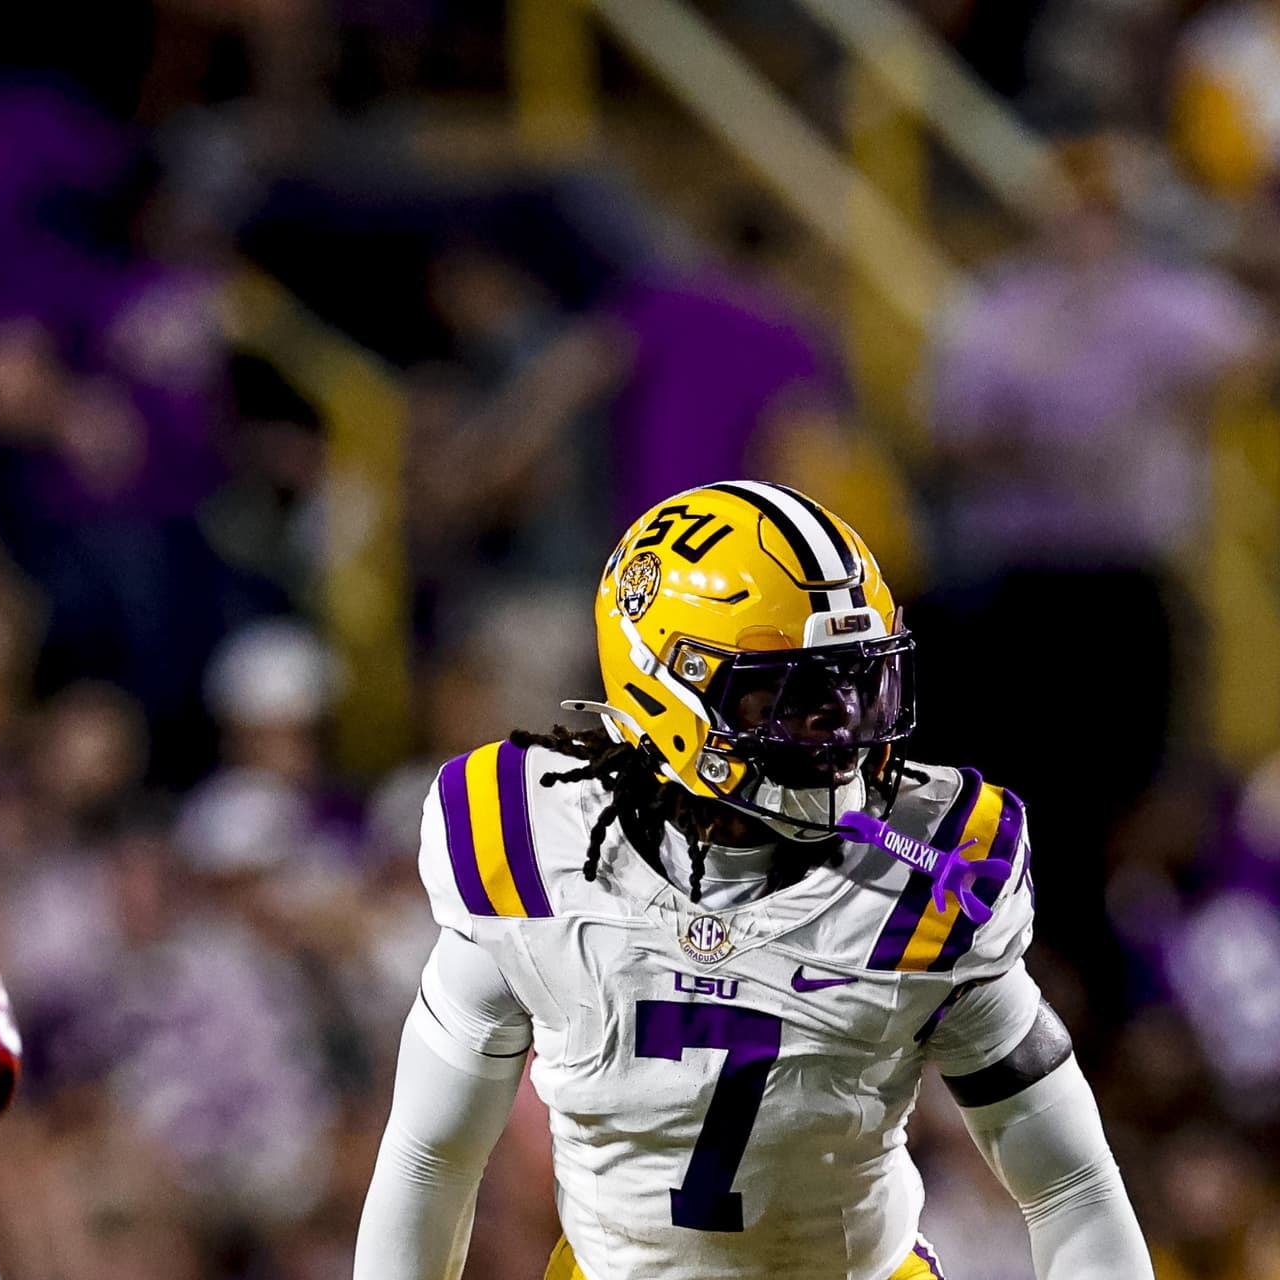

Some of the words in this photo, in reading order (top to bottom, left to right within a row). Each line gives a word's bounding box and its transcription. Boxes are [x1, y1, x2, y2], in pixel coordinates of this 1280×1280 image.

[825, 613, 871, 636] LSU
[884, 832, 939, 873] NXTRND
[690, 916, 725, 950] SEC
[683, 943, 726, 962] GRADUATE
[674, 971, 739, 999] LSU
[635, 1000, 782, 1232] 7
